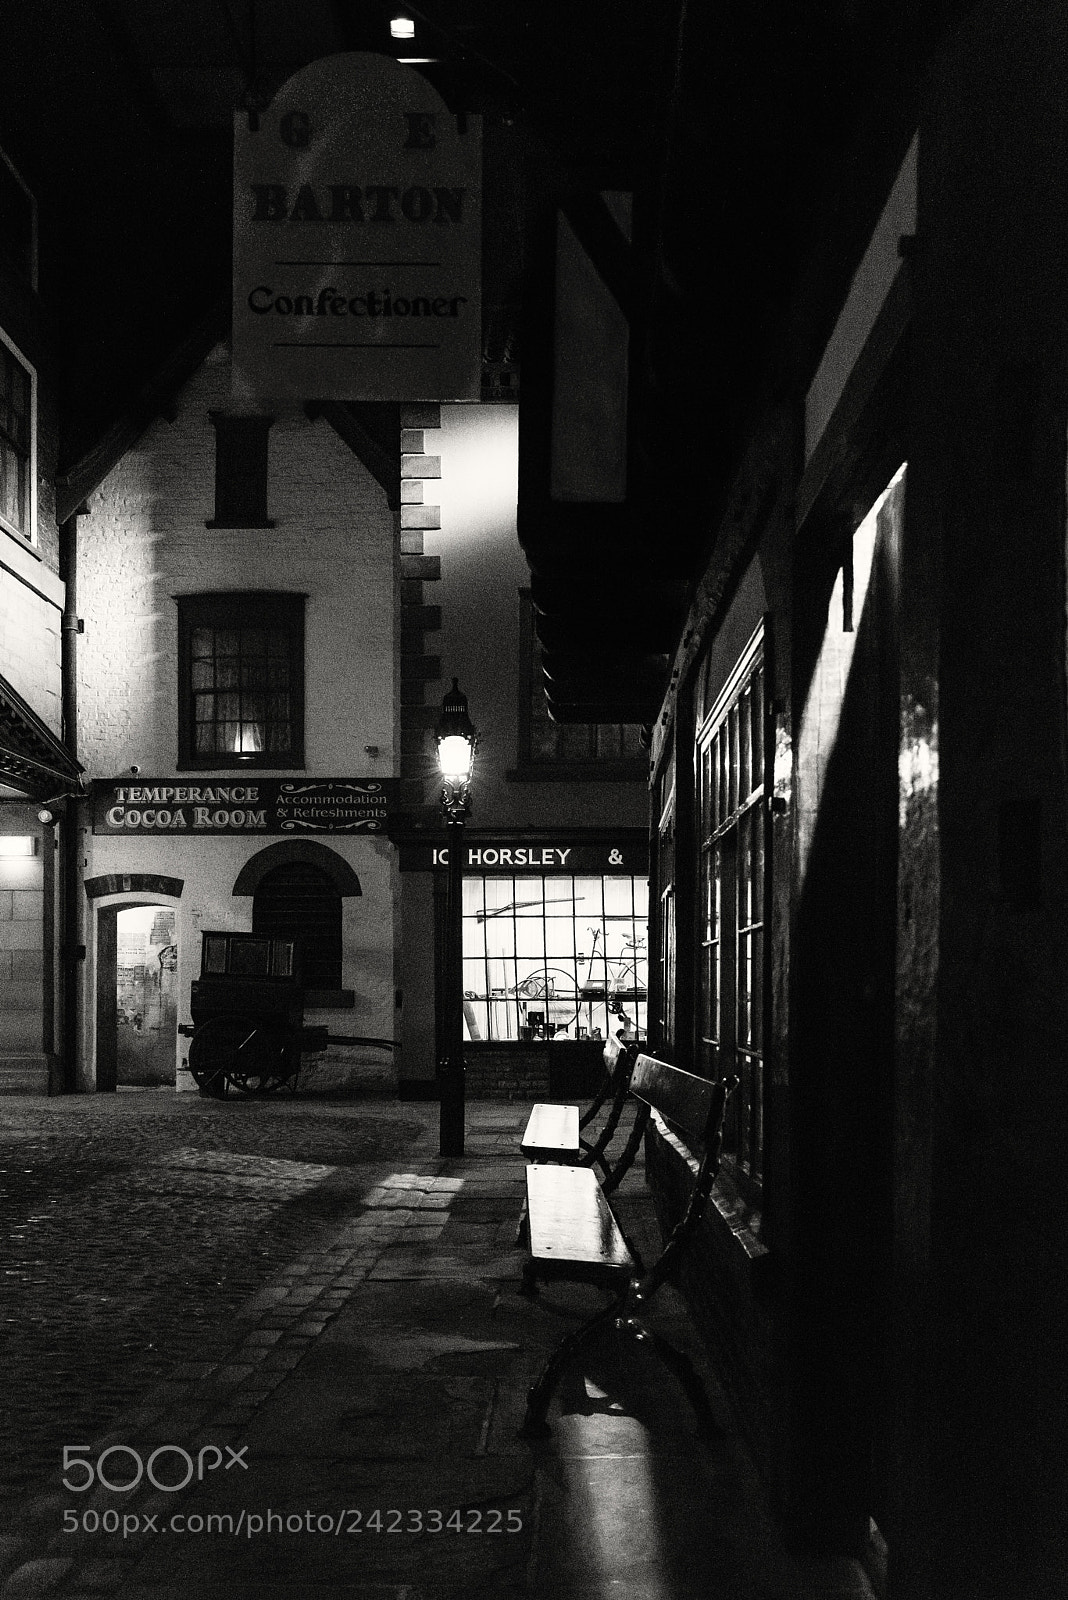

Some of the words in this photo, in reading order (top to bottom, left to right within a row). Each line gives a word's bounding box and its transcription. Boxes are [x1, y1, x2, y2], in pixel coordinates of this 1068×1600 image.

[403, 112, 437, 149] E
[250, 184, 467, 223] BARTON
[248, 286, 467, 317] Confectioner
[114, 786, 260, 804] TEMPERANCE
[275, 794, 388, 805] Accommodation
[276, 807, 288, 818] &
[293, 807, 388, 819] Refreshments
[468, 848, 572, 866] HORSLEY
[607, 848, 624, 866] &
